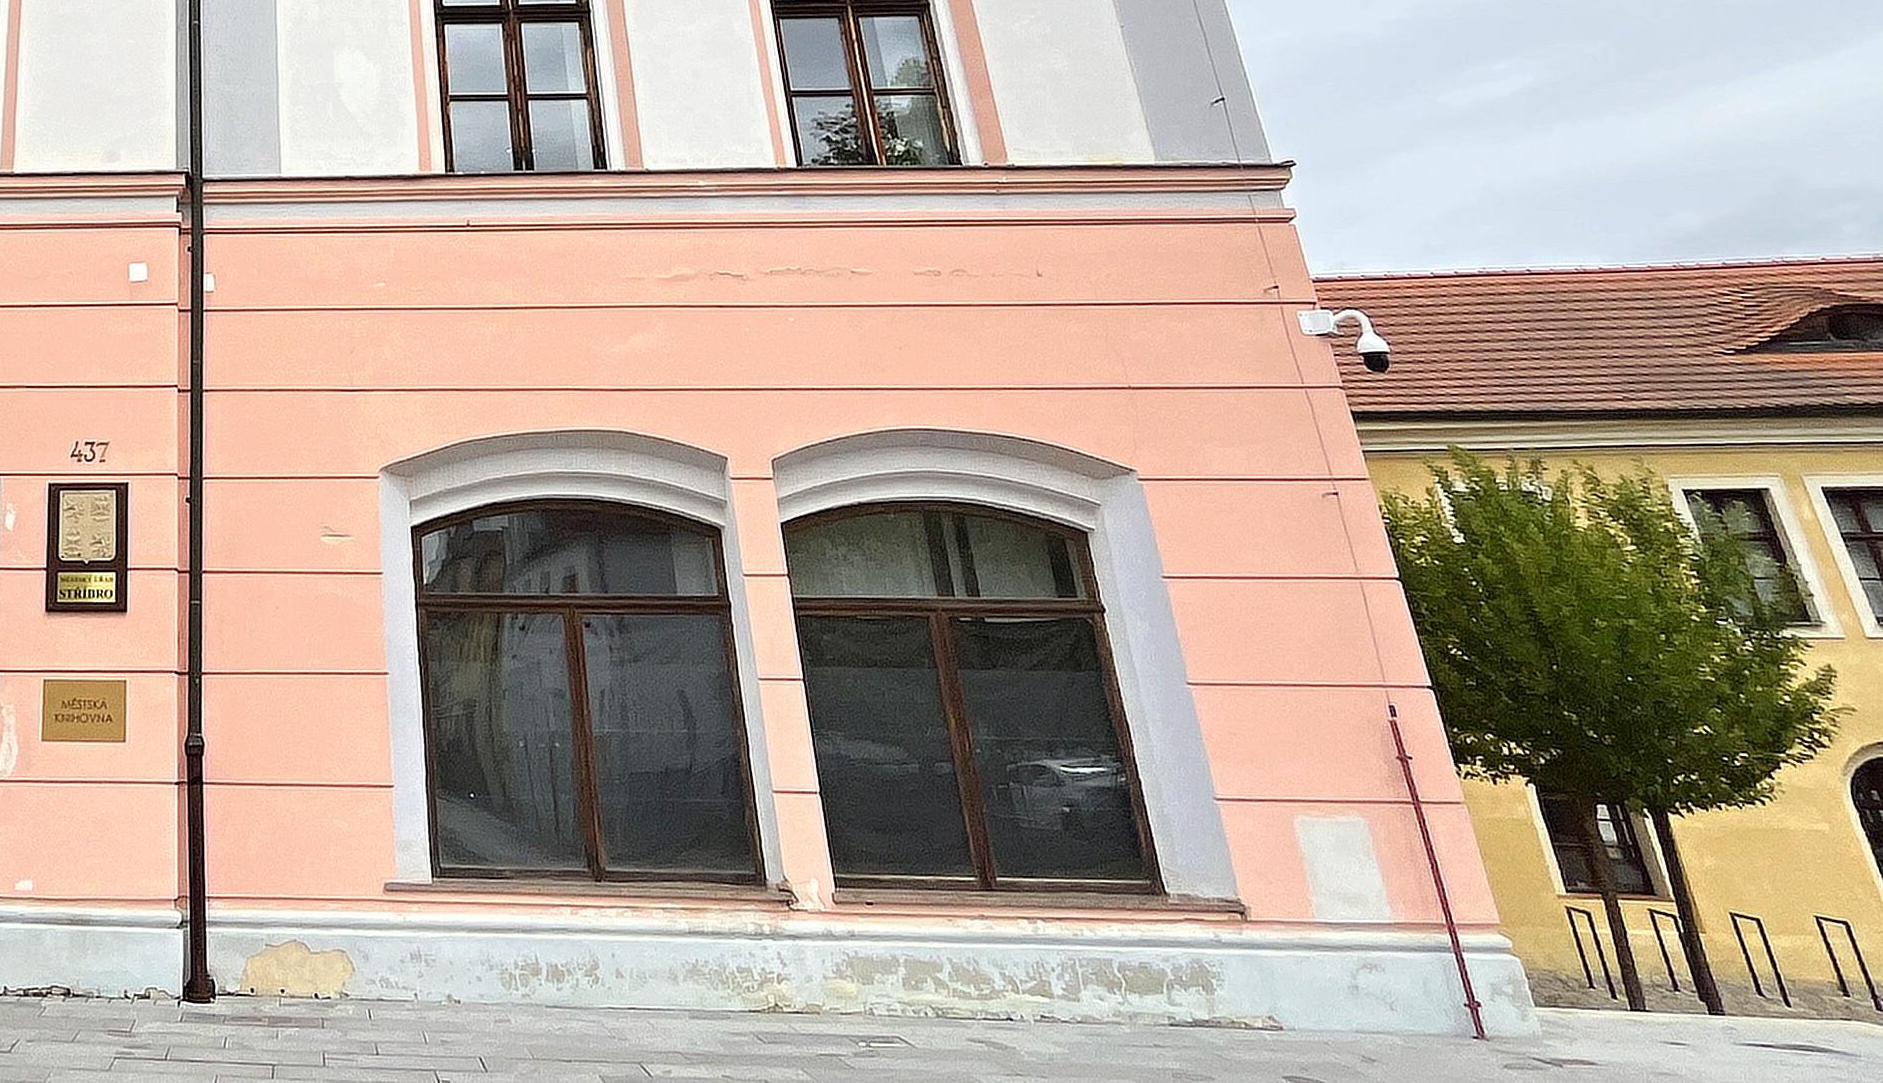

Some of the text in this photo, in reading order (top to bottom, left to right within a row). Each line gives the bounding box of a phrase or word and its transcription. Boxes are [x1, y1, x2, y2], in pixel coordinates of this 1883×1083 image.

[70, 440, 110, 463] 437
[59, 585, 114, 600] STŘÍBRO
[53, 713, 113, 724] KNIHOVNA
